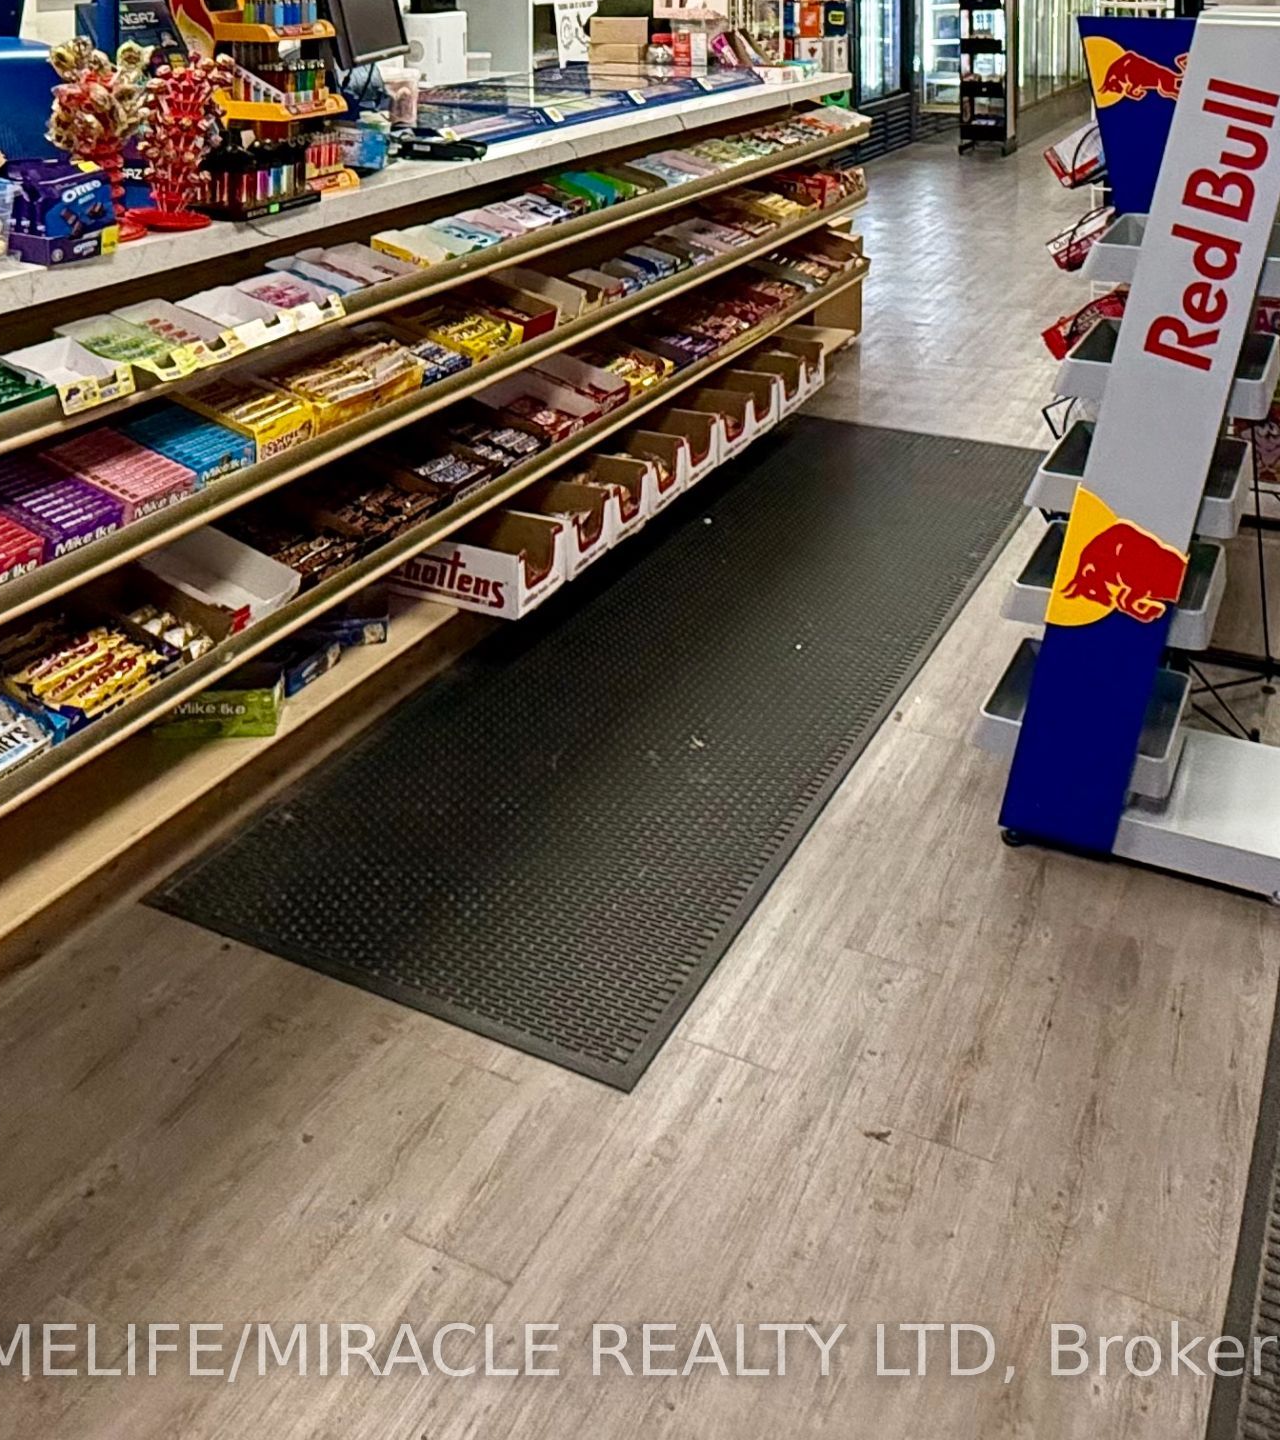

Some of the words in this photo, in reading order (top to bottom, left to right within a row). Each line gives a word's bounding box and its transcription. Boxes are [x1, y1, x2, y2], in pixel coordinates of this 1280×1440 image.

[1181, 77, 1280, 223] Bull
[61, 179, 102, 203] OREO
[1143, 222, 1243, 372] Red
[54, 531, 93, 558] Mike
[95, 522, 118, 540] Ike
[13, 558, 38, 579] Ike
